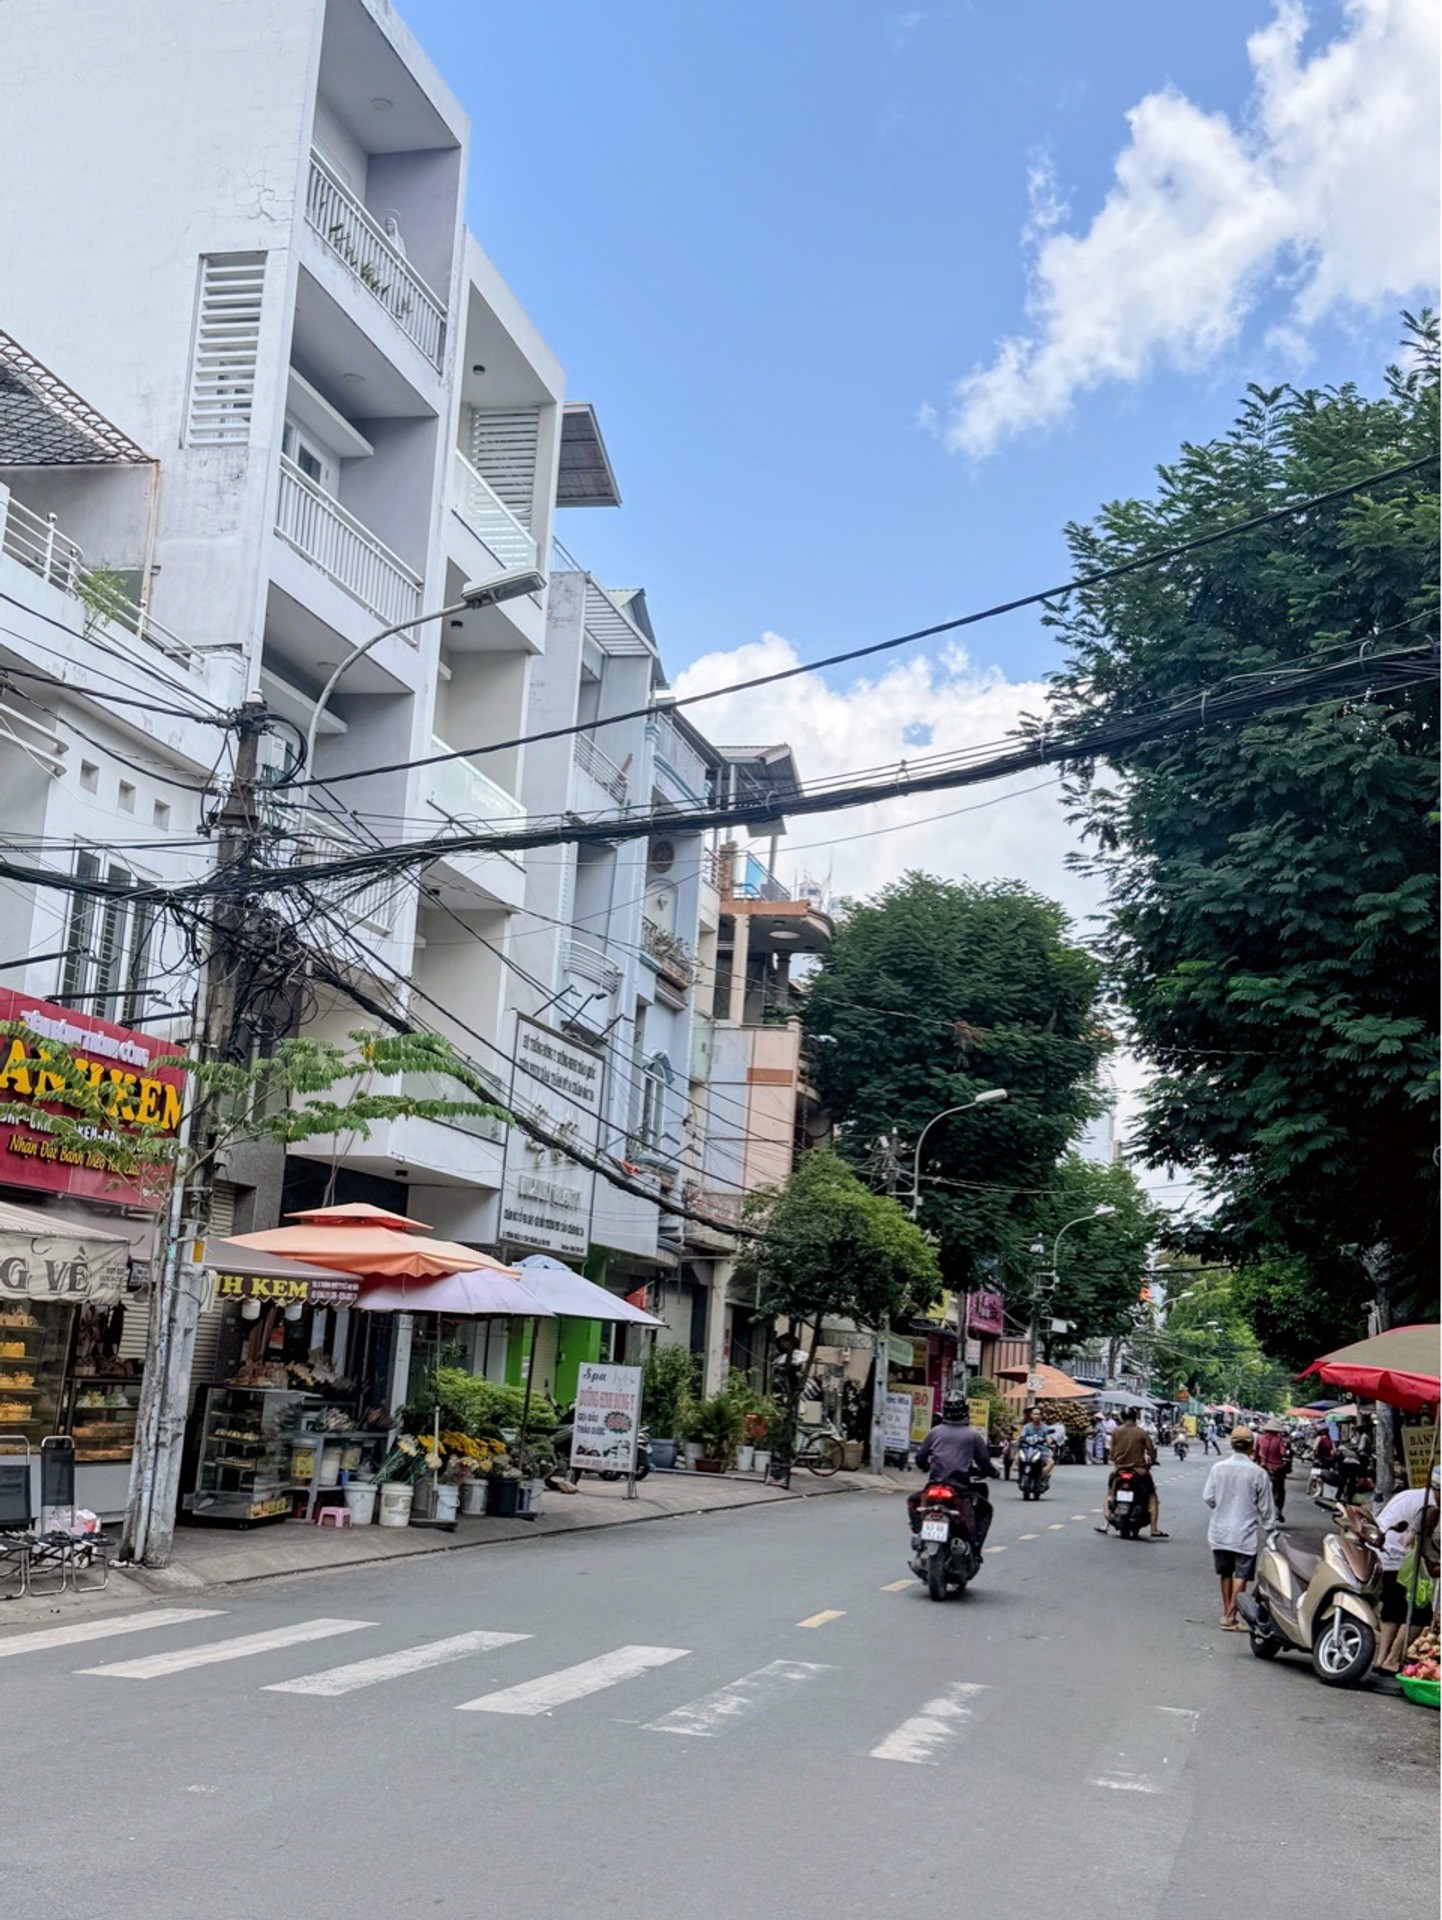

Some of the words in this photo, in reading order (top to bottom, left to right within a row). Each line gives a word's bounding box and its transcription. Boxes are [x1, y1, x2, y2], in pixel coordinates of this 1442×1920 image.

[44, 1245, 91, 1296] VỀ
[251, 1278, 308, 1298] KEM
[583, 1368, 607, 1383] Spa
